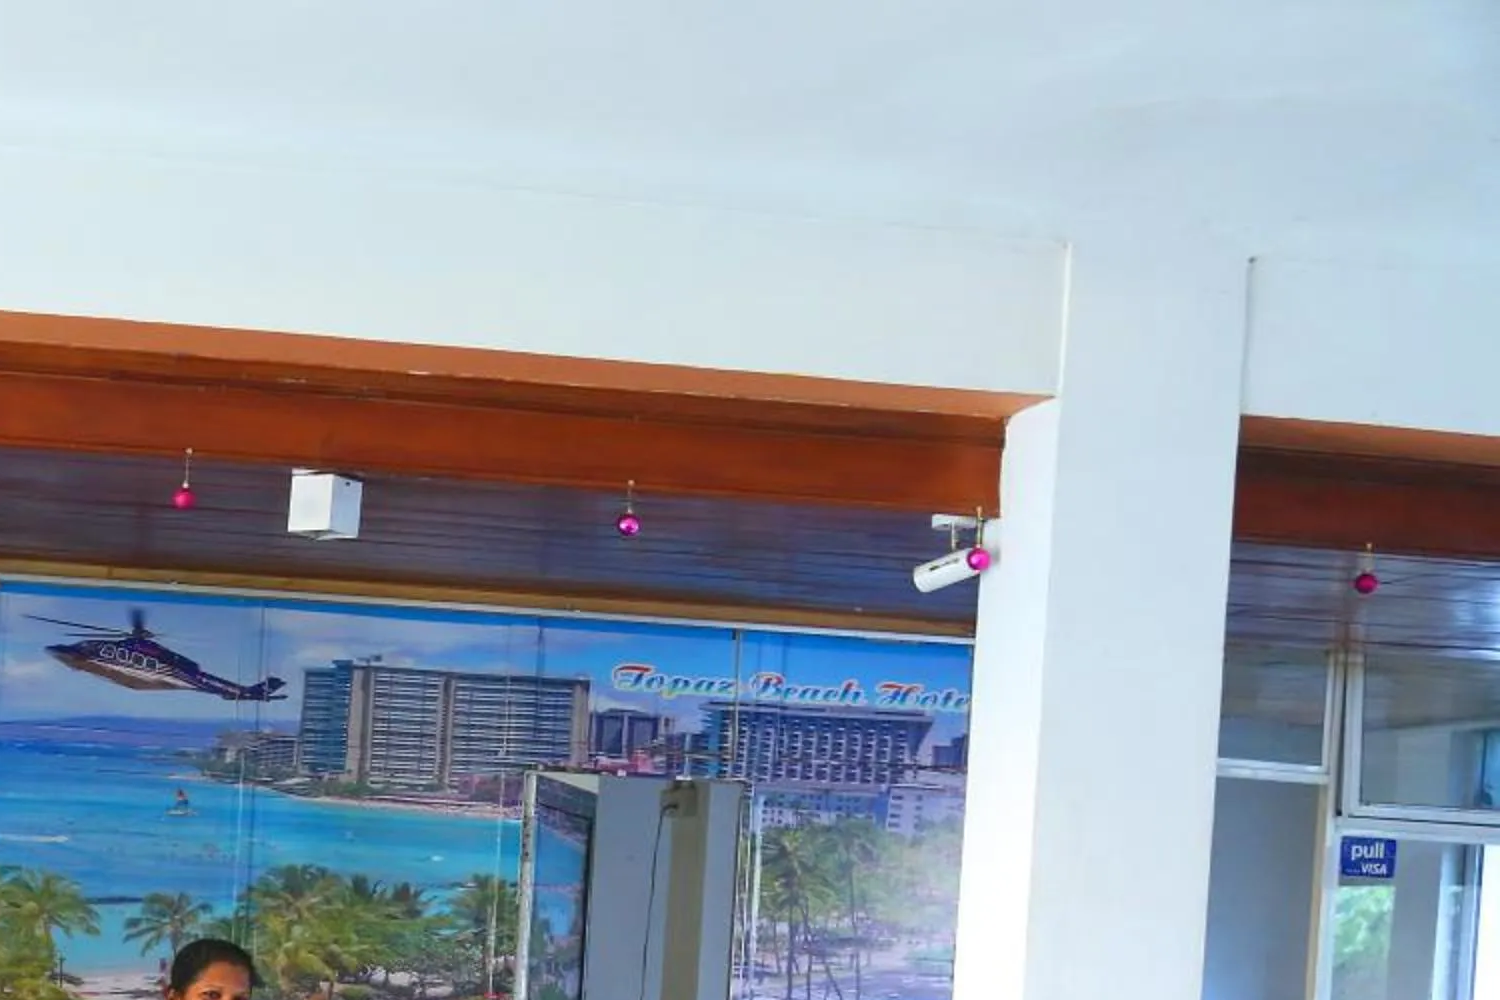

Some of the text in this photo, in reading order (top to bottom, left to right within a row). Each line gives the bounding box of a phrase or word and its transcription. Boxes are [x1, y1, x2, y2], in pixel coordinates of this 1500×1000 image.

[612, 664, 971, 711] Topaz Beach Hote
[1351, 842, 1385, 861] pull
[1361, 863, 1387, 875] VISA
